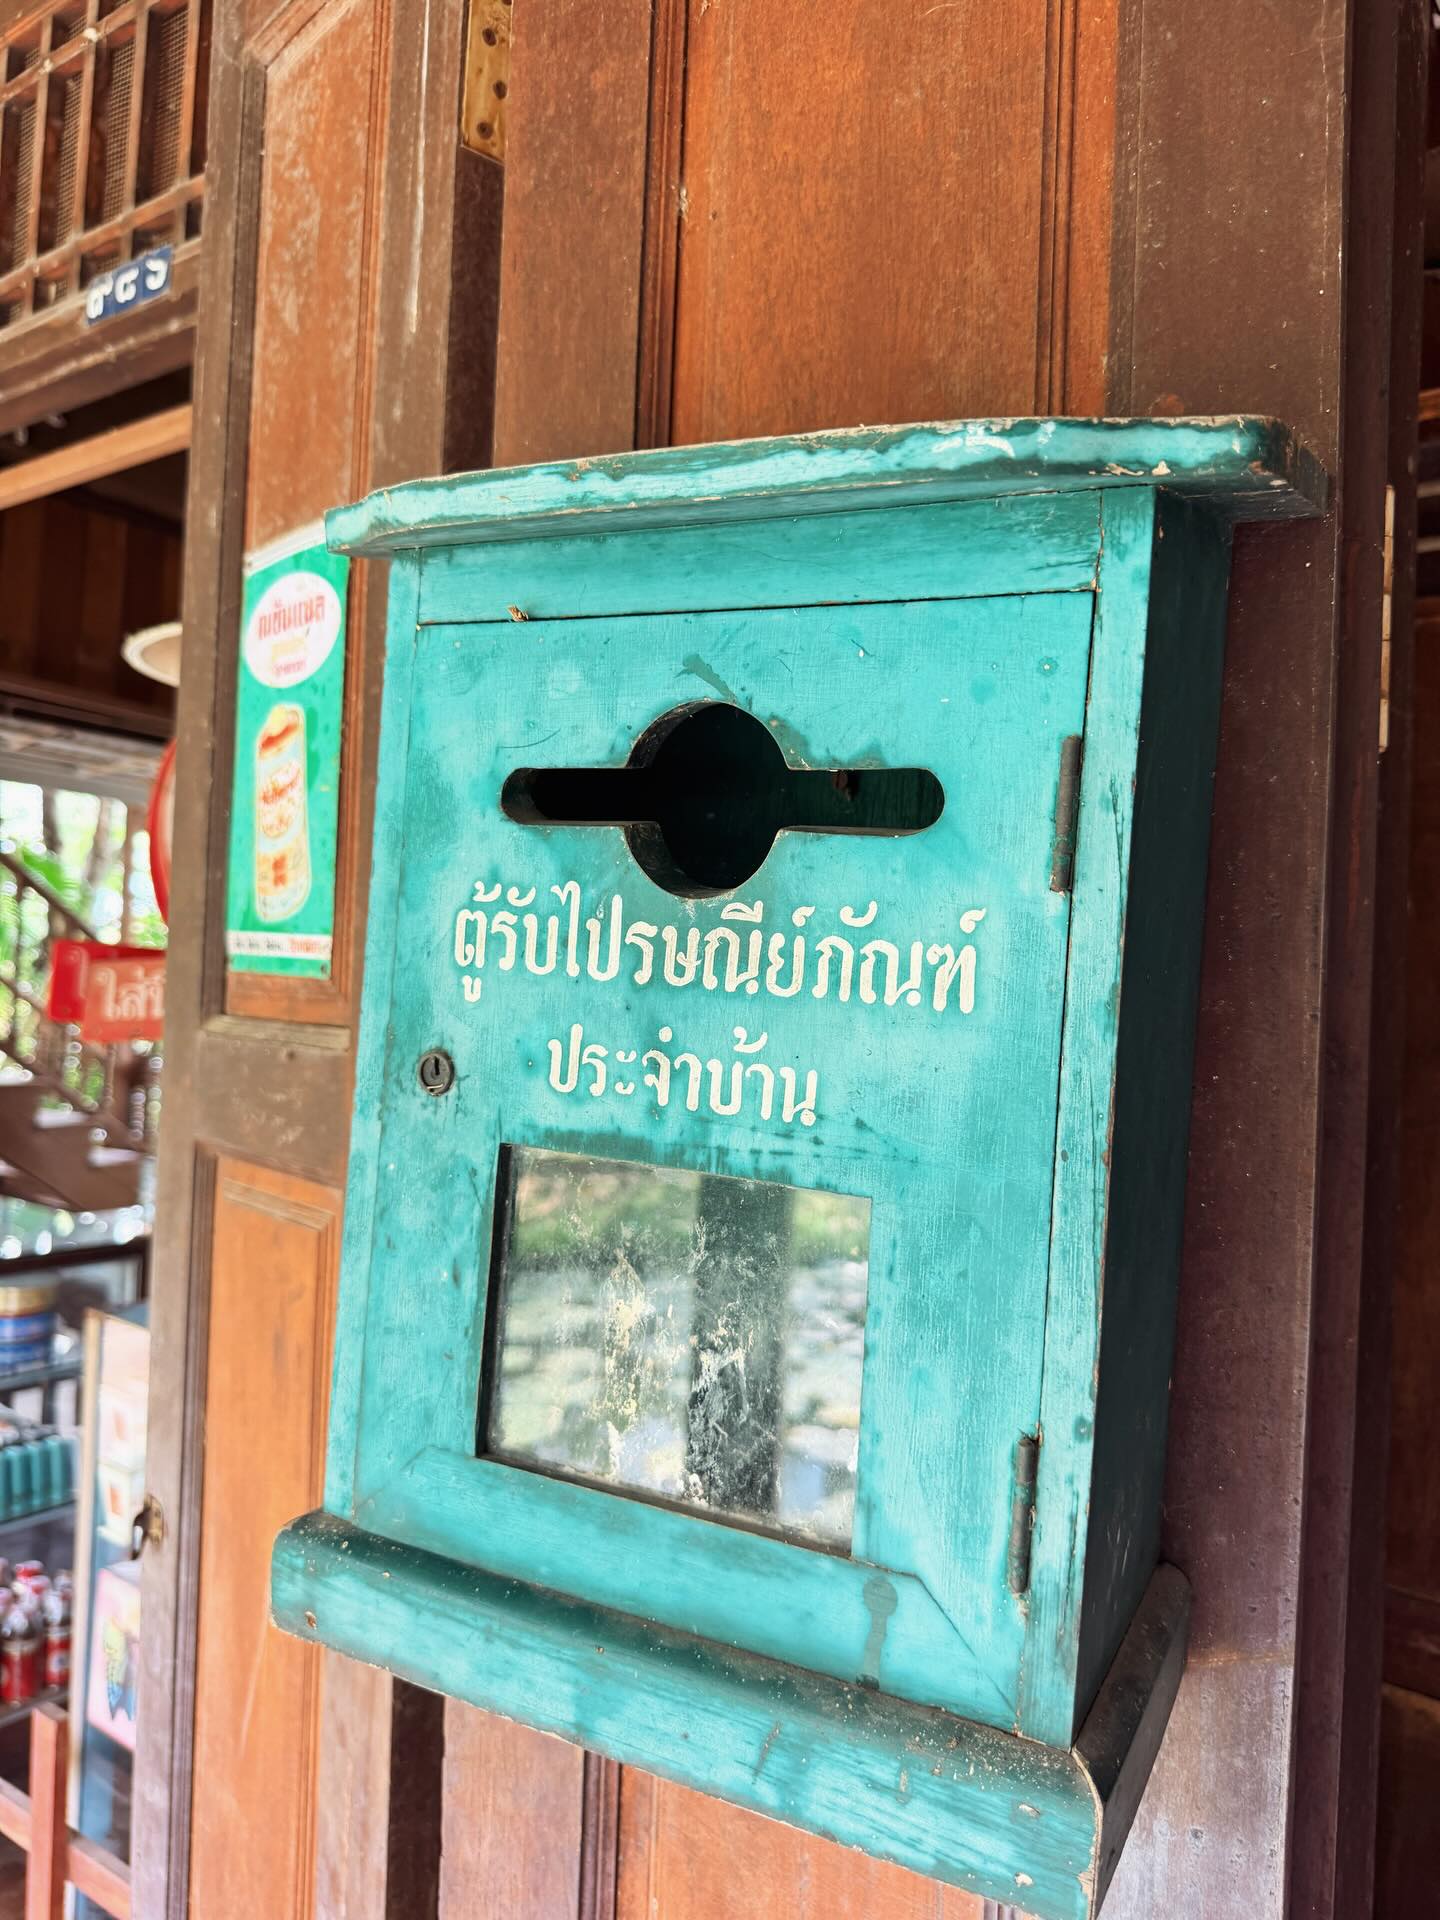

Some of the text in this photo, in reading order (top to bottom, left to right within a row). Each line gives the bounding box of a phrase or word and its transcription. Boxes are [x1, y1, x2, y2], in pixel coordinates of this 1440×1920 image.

[454, 880, 986, 1014] ตู้รับไปรษณีย์ภัณฑ์
[548, 1023, 818, 1126] ประจำบ้าน
